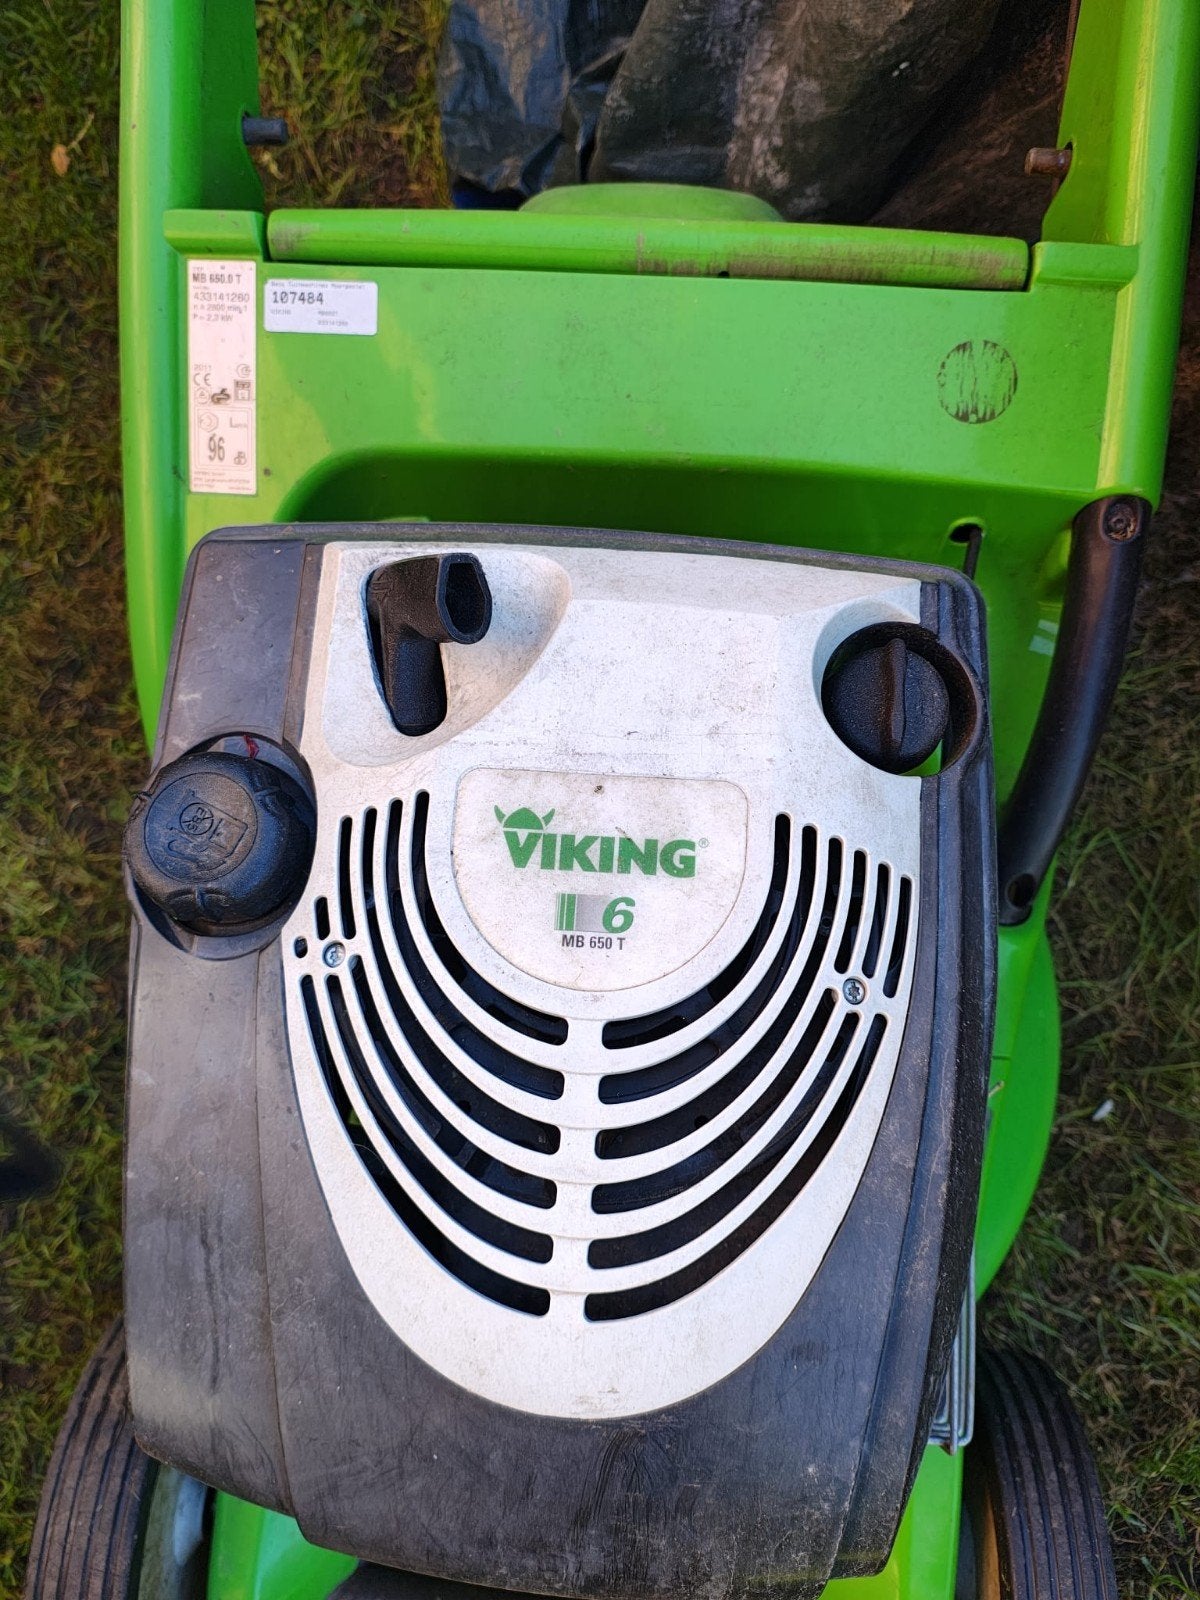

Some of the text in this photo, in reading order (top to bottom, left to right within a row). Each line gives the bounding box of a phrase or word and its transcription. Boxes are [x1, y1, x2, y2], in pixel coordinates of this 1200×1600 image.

[192, 273, 207, 283] MB
[235, 274, 242, 284] T
[271, 291, 324, 305] 107484
[207, 436, 226, 462] 96
[503, 829, 697, 879] VIKING
[602, 896, 636, 934] 6
[561, 934, 626, 951] MB 650 T
